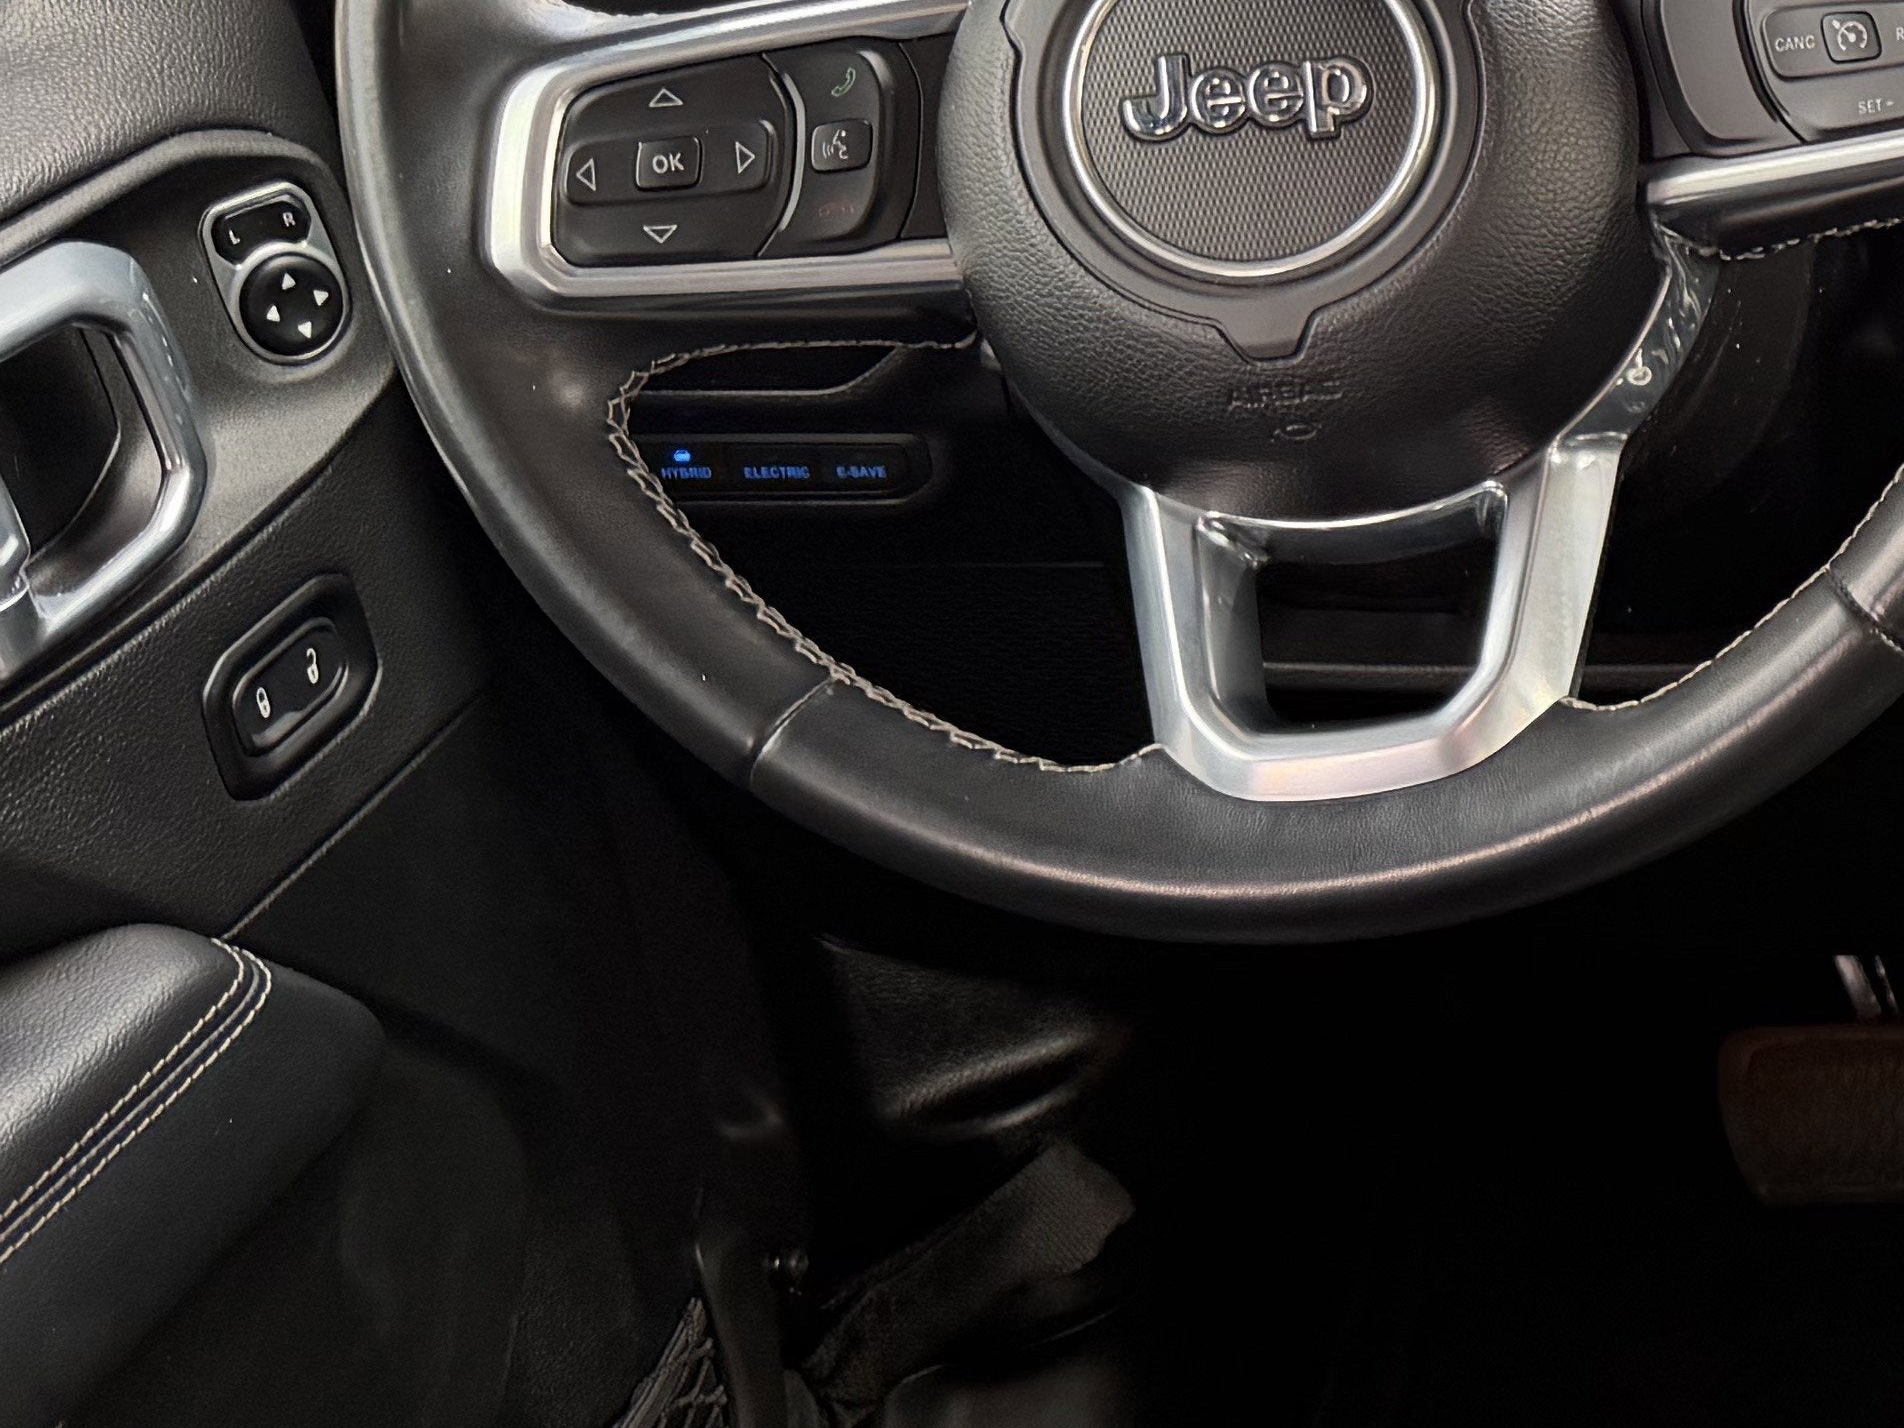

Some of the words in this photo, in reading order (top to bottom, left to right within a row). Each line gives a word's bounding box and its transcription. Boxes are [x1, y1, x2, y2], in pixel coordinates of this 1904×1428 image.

[1773, 32, 1816, 53] CANC
[1120, 53, 1374, 143] Jeep
[651, 151, 685, 176] OK
[281, 211, 296, 227] R
[229, 228, 241, 245] L
[660, 466, 712, 480] HYBRID
[743, 466, 810, 480] ELECTRIC
